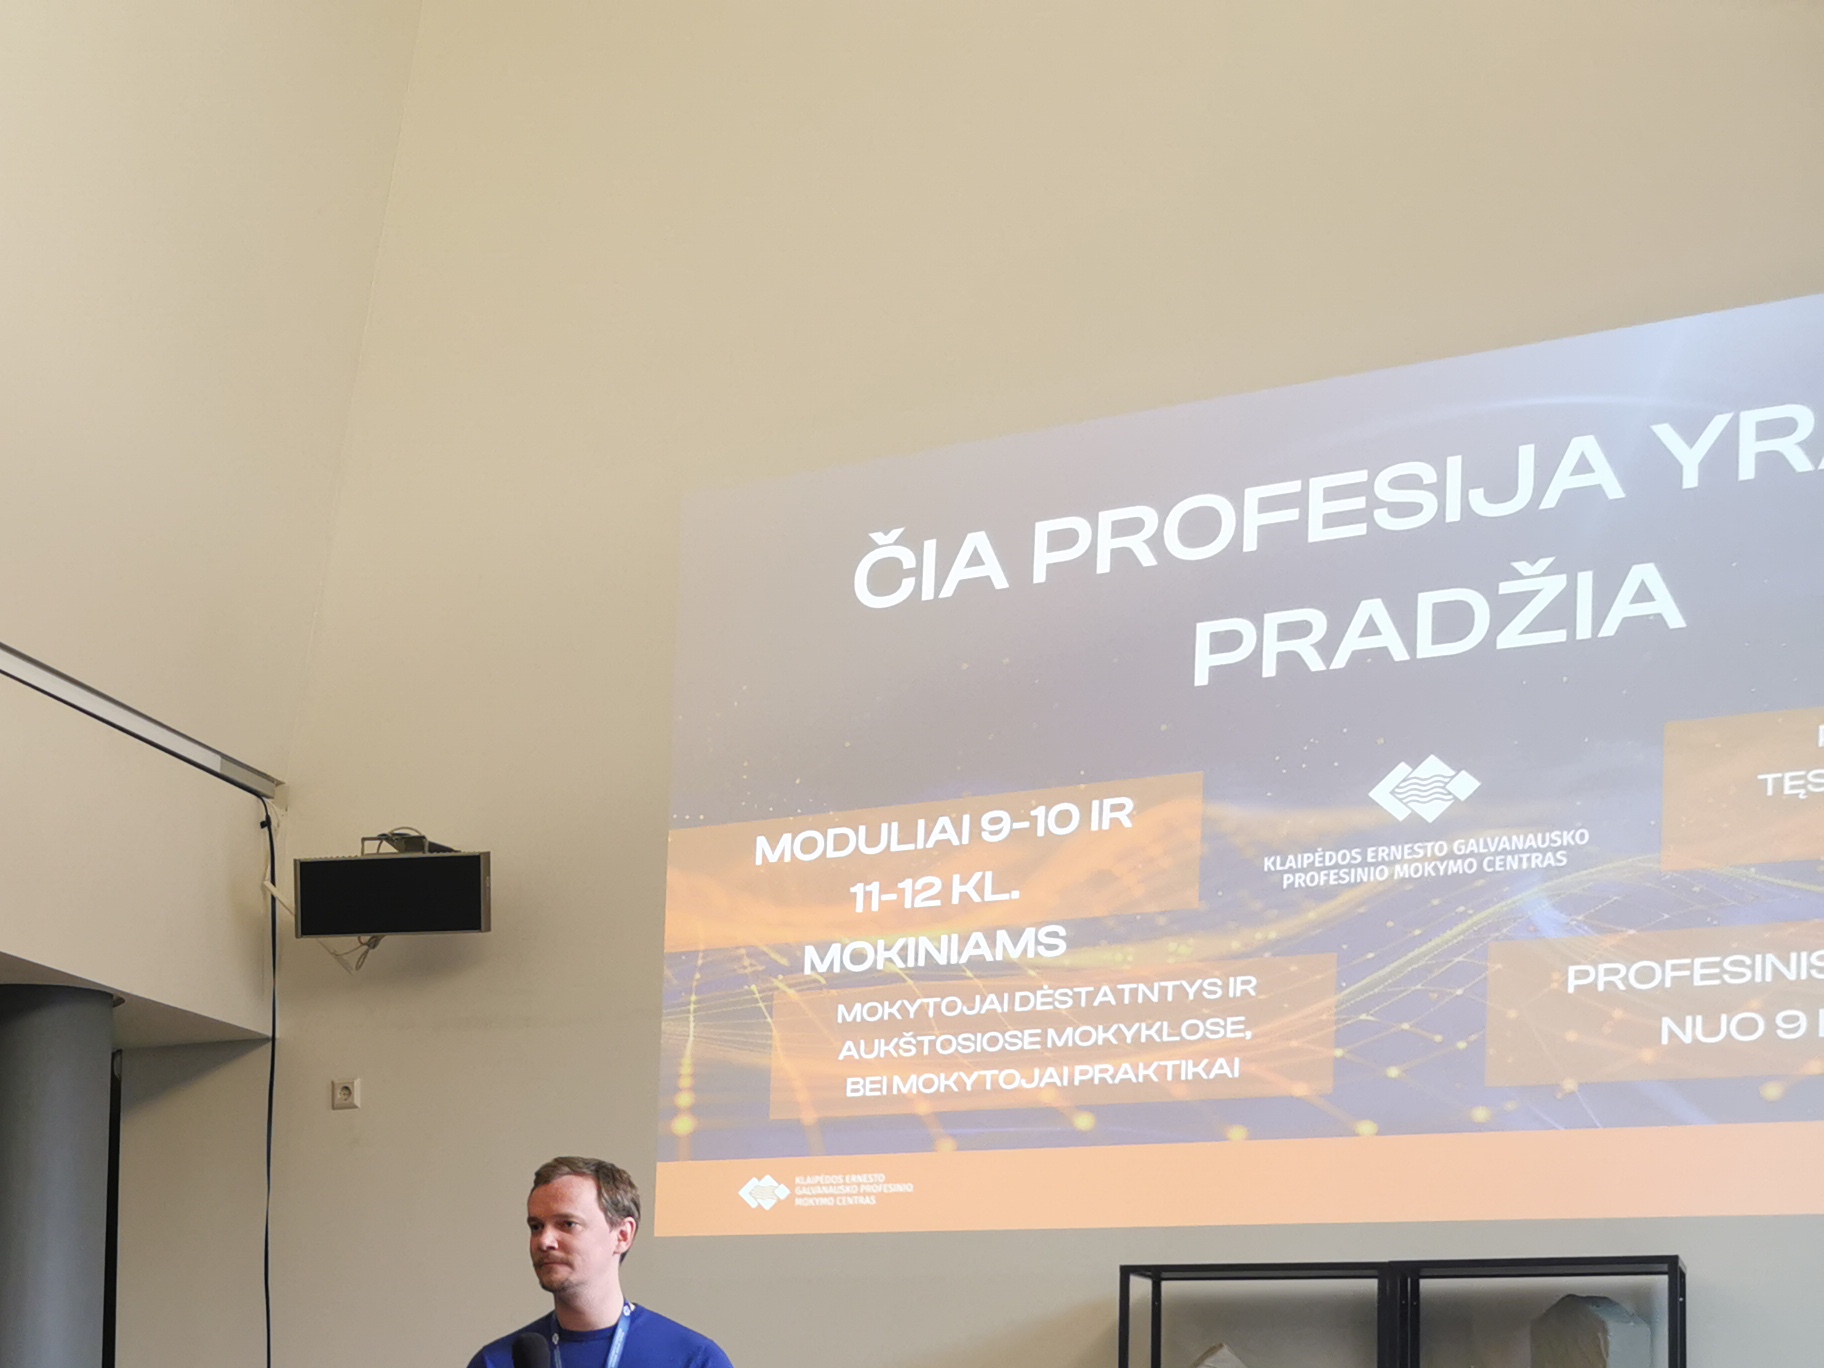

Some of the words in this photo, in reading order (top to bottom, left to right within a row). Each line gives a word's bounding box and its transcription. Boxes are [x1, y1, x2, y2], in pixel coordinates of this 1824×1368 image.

[854, 527, 1010, 609] ČIA
[1032, 434, 1626, 584] PROFESIJA
[1649, 403, 1824, 490] YR
[1193, 556, 1687, 687] PRADŽIA
[755, 813, 971, 866] MODULIAI
[980, 802, 1081, 843] 9-10
[1090, 796, 1135, 832] IR
[1263, 847, 1363, 872] KLAIPĖDOS
[1367, 840, 1448, 863] ERNESTO
[1453, 828, 1590, 855] GALVANAUSKO
[849, 875, 943, 913] 11-12
[951, 870, 1021, 905] KL.
[1282, 865, 1389, 890] PROFESINIO
[1393, 857, 1477, 881] MOKYMO
[1482, 850, 1568, 873] CENTRAS
[803, 924, 1067, 976] MOKINIAMS
[837, 992, 1009, 1024] MOKYTOJAI
[1013, 977, 1223, 1012] DĖSTATNTYS
[1228, 975, 1258, 998] IR
[837, 1028, 1043, 1061] AUKŠTOSIOSE
[1046, 1015, 1253, 1049] MOKYKLOSE,
[1661, 1011, 1766, 1045] NUO
[1775, 1009, 1808, 1040] 9
[845, 1075, 888, 1098] BEI
[892, 1065, 1069, 1095] MOKYTOJAI
[1073, 1056, 1241, 1086] PRAKTIKAI
